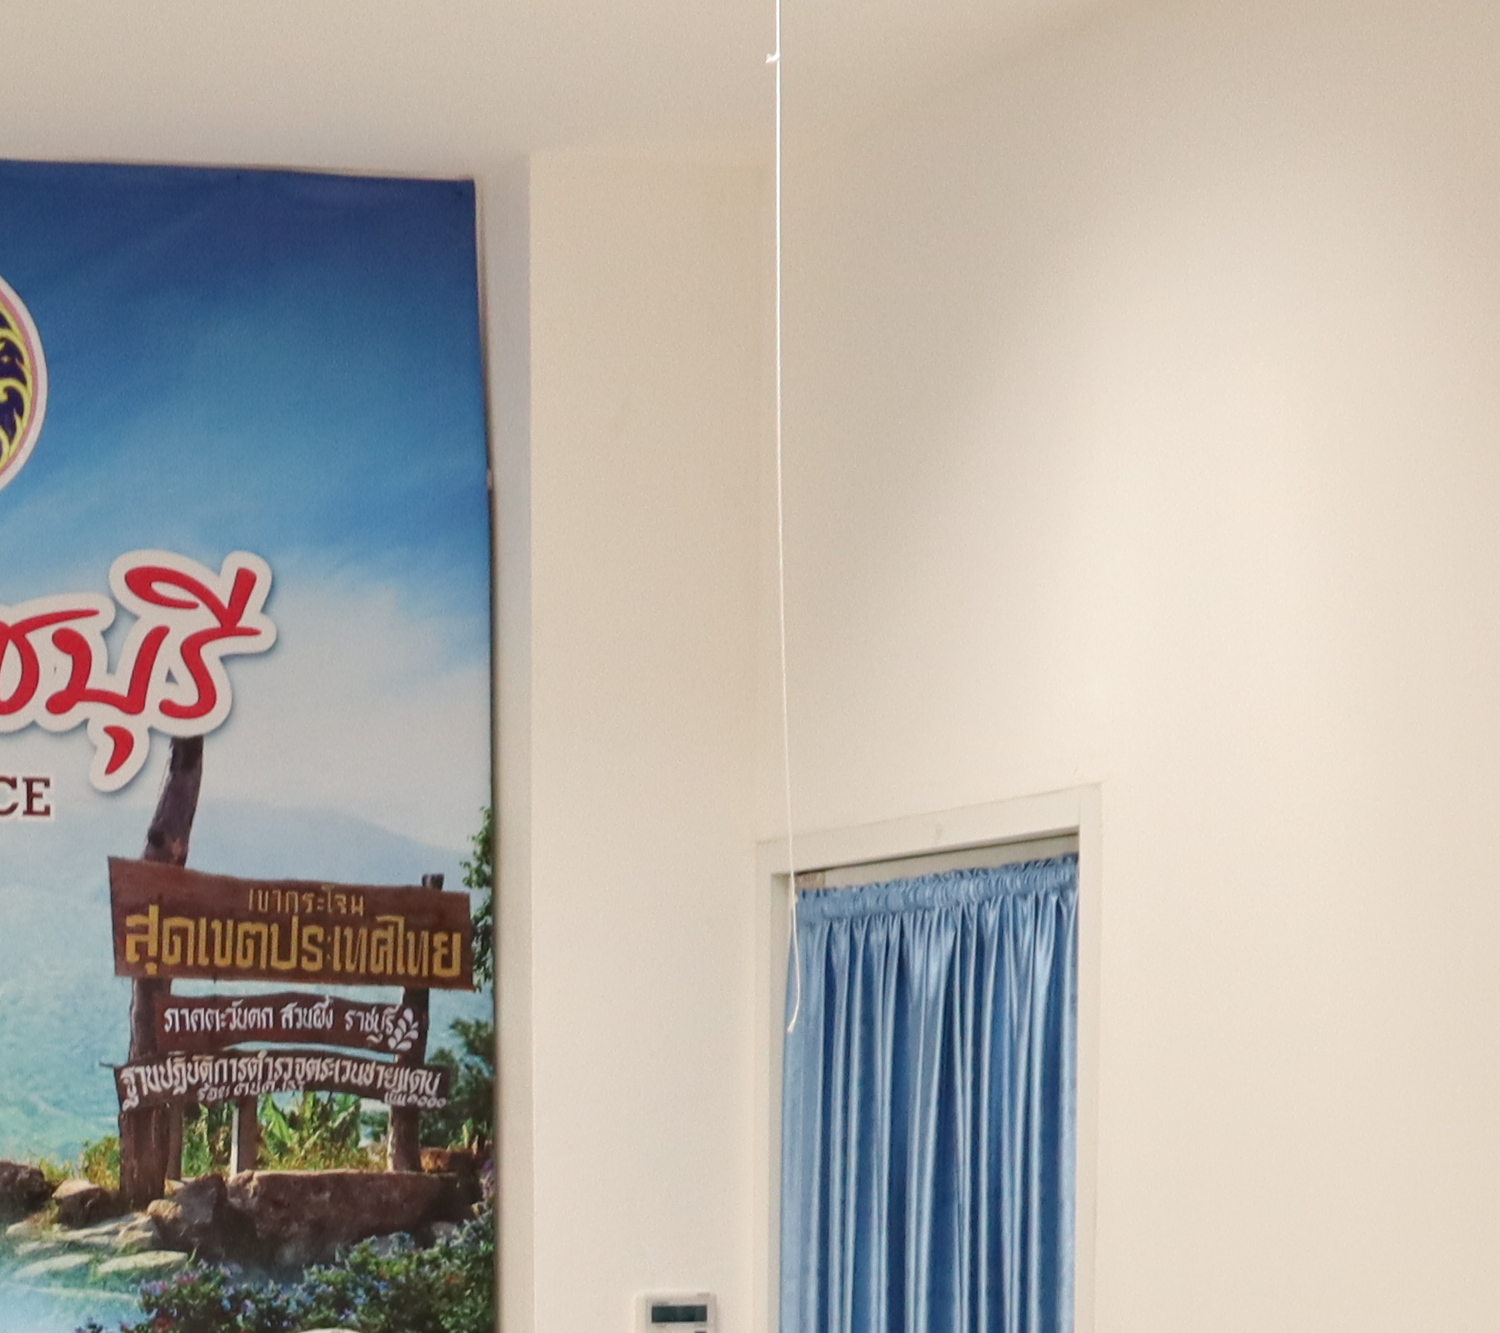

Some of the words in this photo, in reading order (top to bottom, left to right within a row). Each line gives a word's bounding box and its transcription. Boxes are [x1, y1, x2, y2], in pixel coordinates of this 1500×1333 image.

[248, 883, 365, 917] เขากระโจม
[125, 904, 463, 978] สุดเขตประเทศไทย
[163, 999, 275, 1033] ภาคตะวันตก
